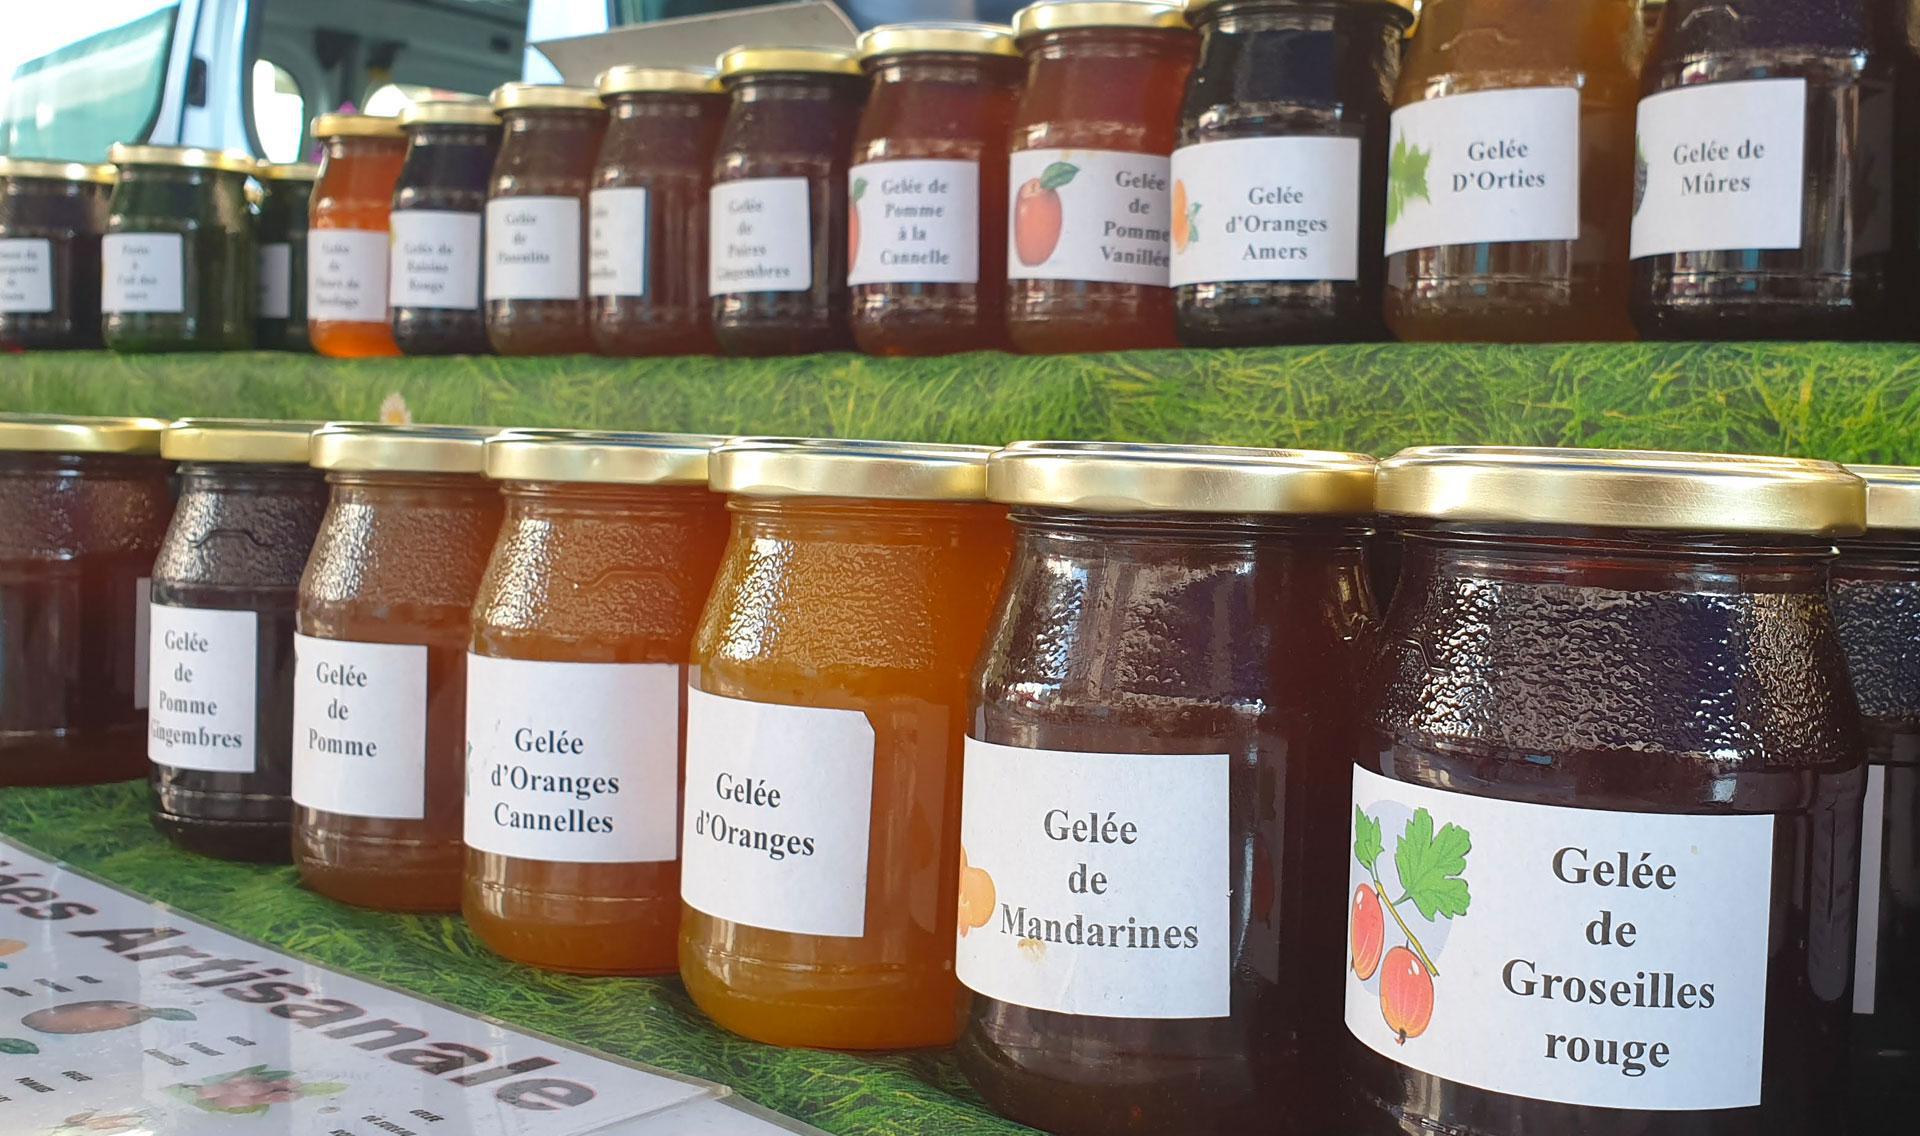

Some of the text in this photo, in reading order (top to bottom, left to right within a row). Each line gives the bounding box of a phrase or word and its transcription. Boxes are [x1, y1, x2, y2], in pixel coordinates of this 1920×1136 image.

[1467, 139, 1530, 162] Gelée
[1673, 138, 1765, 165] Gelée de
[881, 178, 948, 195] Gelée de
[1116, 170, 1167, 192] Gelée
[1681, 172, 1752, 197] Mûres
[1128, 198, 1151, 215] de
[1248, 186, 1304, 205] Gelée
[885, 204, 945, 219] Pomme
[898, 226, 927, 241] à la
[880, 250, 949, 265] Cannelle
[1242, 244, 1308, 261] Amers
[164, 629, 209, 653] Gelée
[174, 662, 194, 684] de
[316, 661, 368, 688] Gelée
[159, 690, 218, 717] Pomme
[328, 698, 349, 721] de
[308, 728, 378, 758] Pomme
[514, 727, 585, 756] Gelée
[716, 771, 782, 808] Gelée
[494, 802, 614, 834] Cannelles
[1043, 809, 1138, 845] Gelée
[1068, 862, 1108, 895] de
[1551, 846, 1677, 891] Gelée
[1000, 902, 1199, 949] Mandarines
[1585, 910, 1637, 948] de
[1501, 959, 1716, 1009] Groseilles
[67, 926, 597, 1111] Artisanale
[1545, 1032, 1670, 1077] rouge
